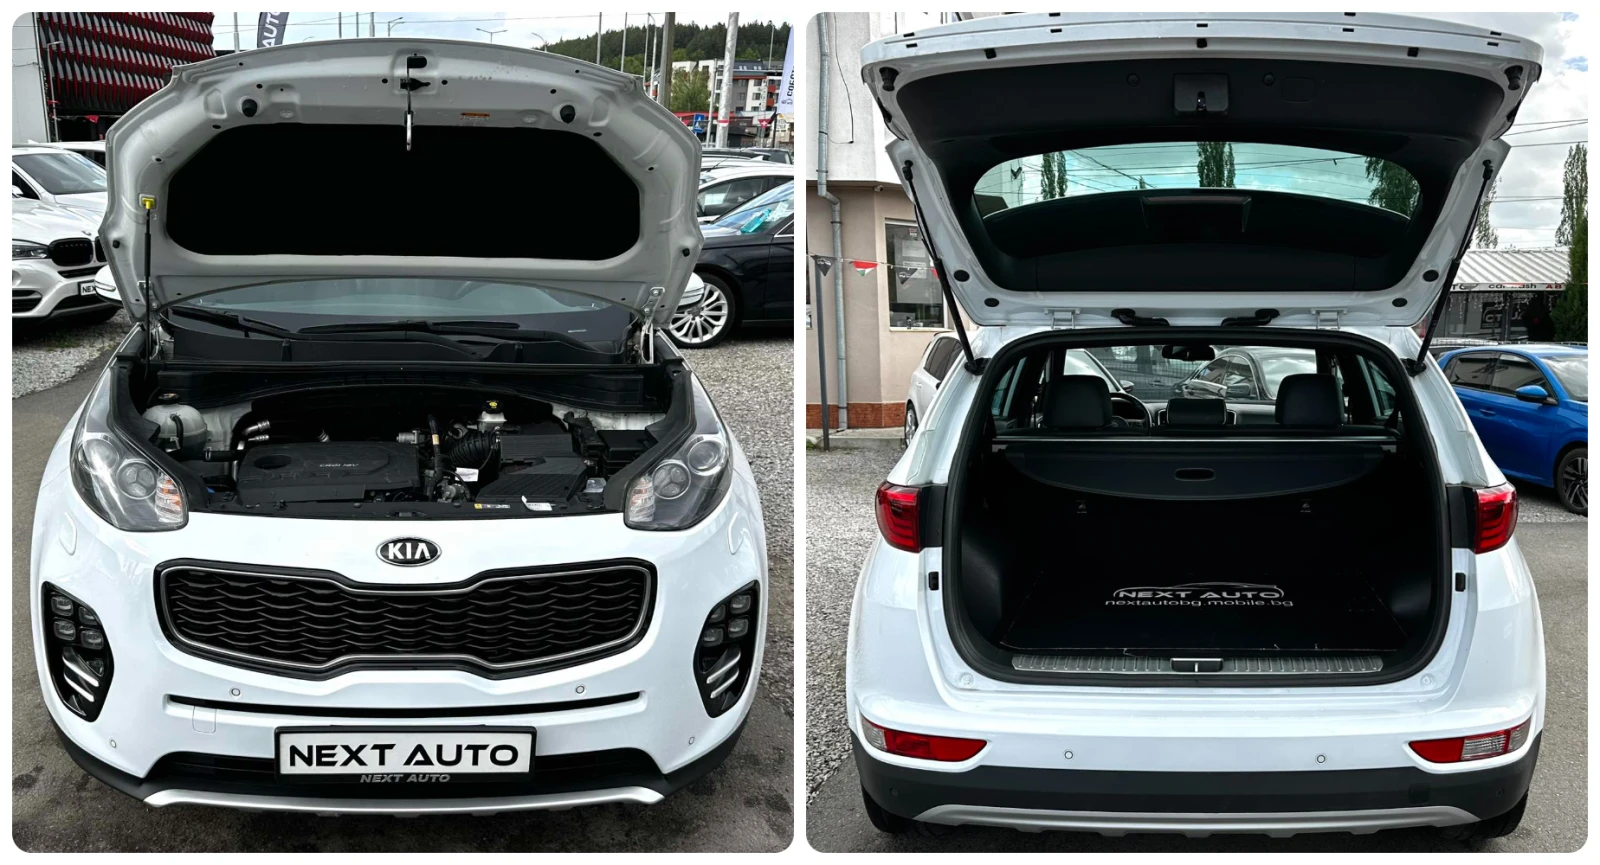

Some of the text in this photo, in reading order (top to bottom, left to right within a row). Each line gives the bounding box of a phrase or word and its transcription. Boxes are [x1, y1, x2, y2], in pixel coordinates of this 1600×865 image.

[82, 285, 97, 294] NEX
[388, 542, 431, 560] KIA
[1105, 599, 1294, 607] nextautobg.mobile.bg
[289, 743, 519, 767] NEXT AUTO
[360, 774, 451, 783] NEXT AUTO
